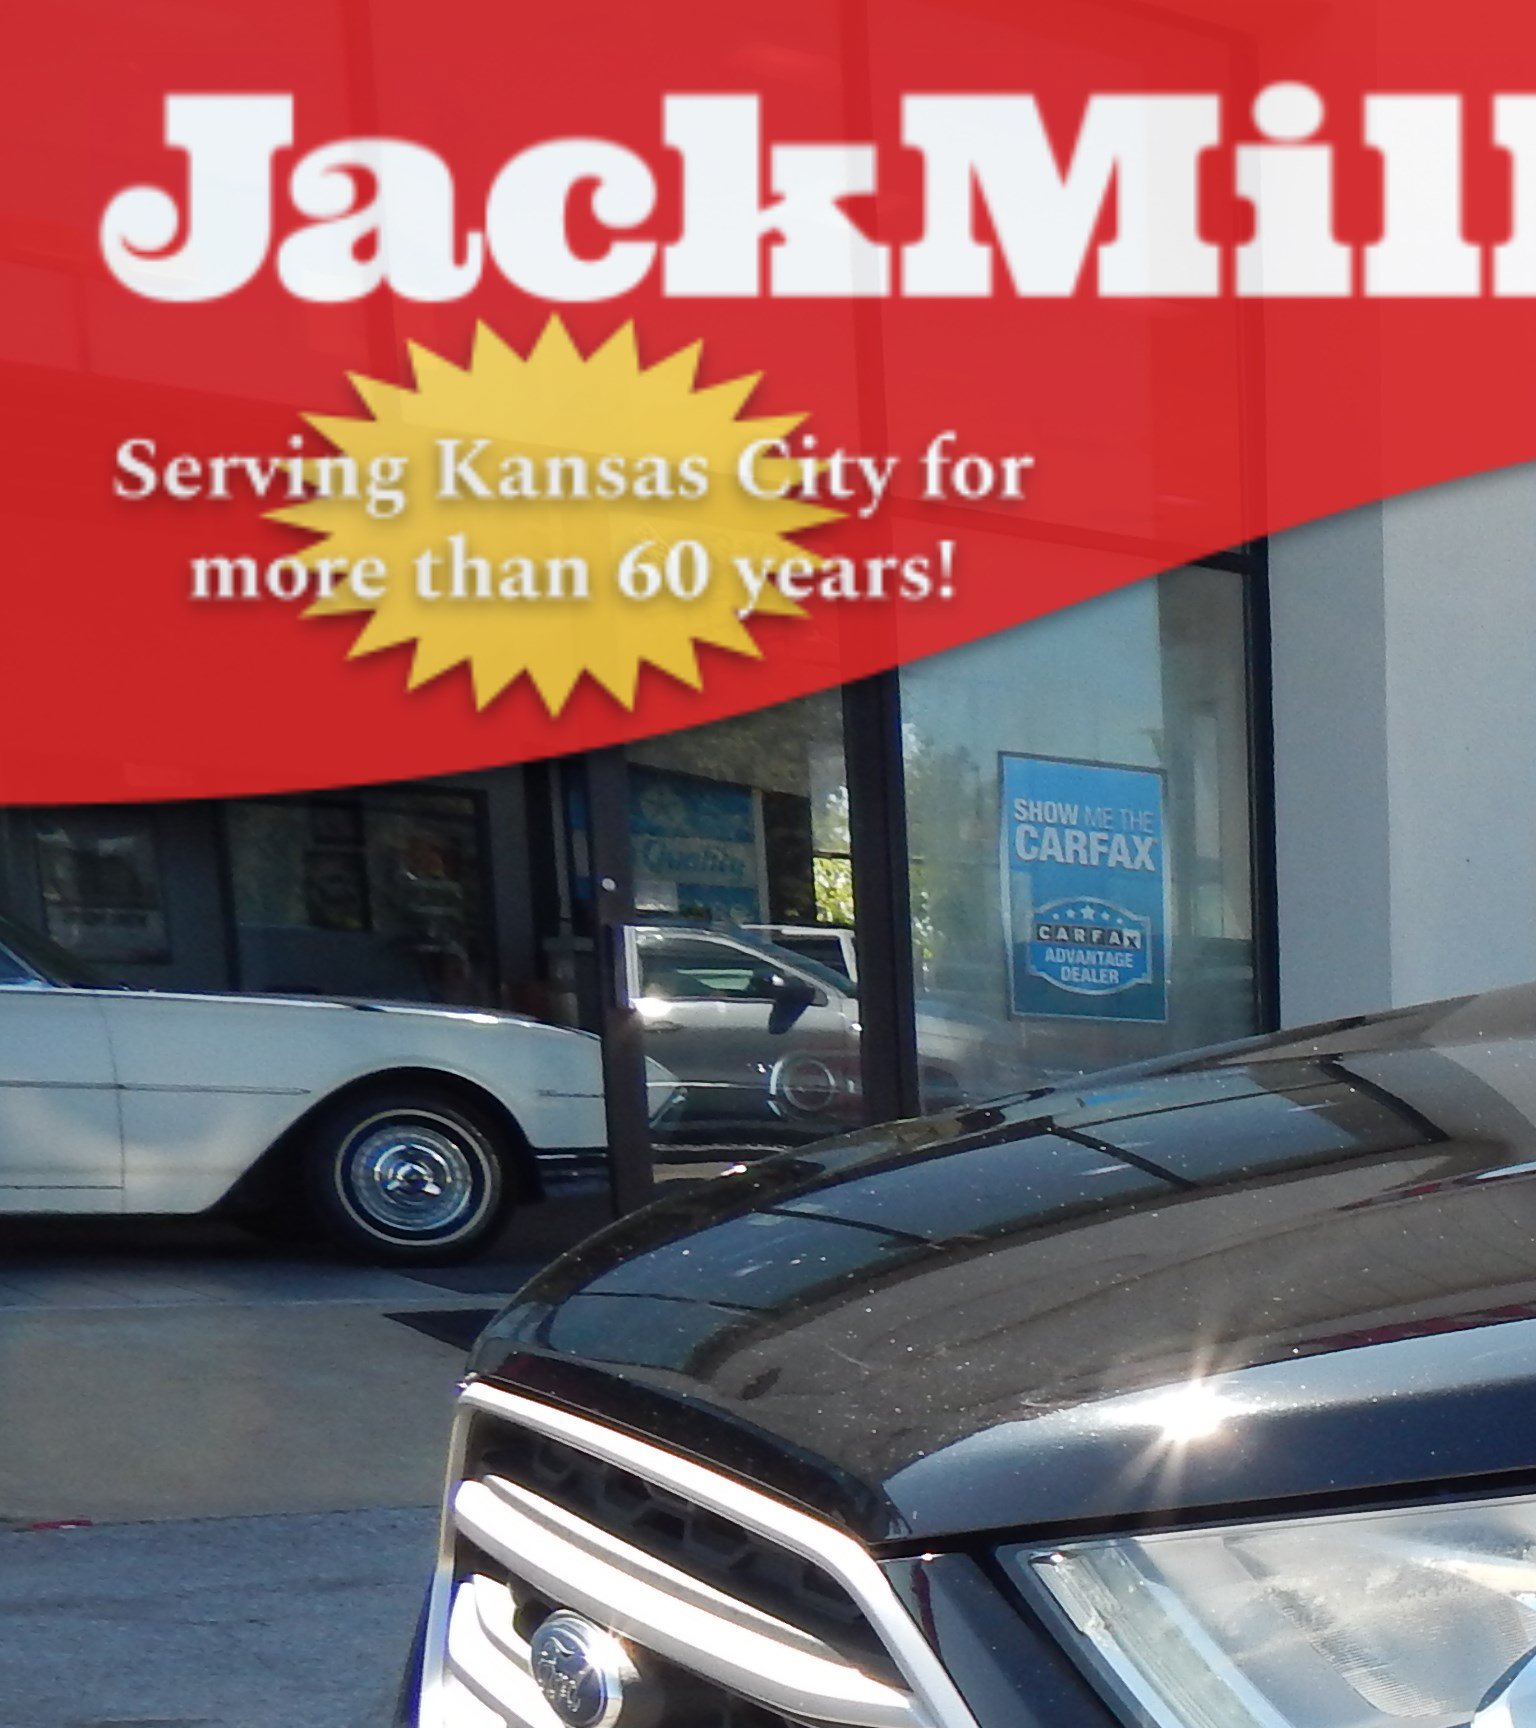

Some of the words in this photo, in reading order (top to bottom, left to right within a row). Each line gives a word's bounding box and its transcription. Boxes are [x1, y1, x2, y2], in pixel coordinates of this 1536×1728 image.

[1014, 797, 1079, 826] SHOW
[1084, 806, 1113, 831] ME
[1121, 808, 1154, 834] THE
[1015, 823, 1158, 872] CARFAX
[1038, 924, 1141, 949] CARFAX
[1045, 947, 1134, 969] ADVANTAGE
[1060, 966, 1120, 985] DEALER
